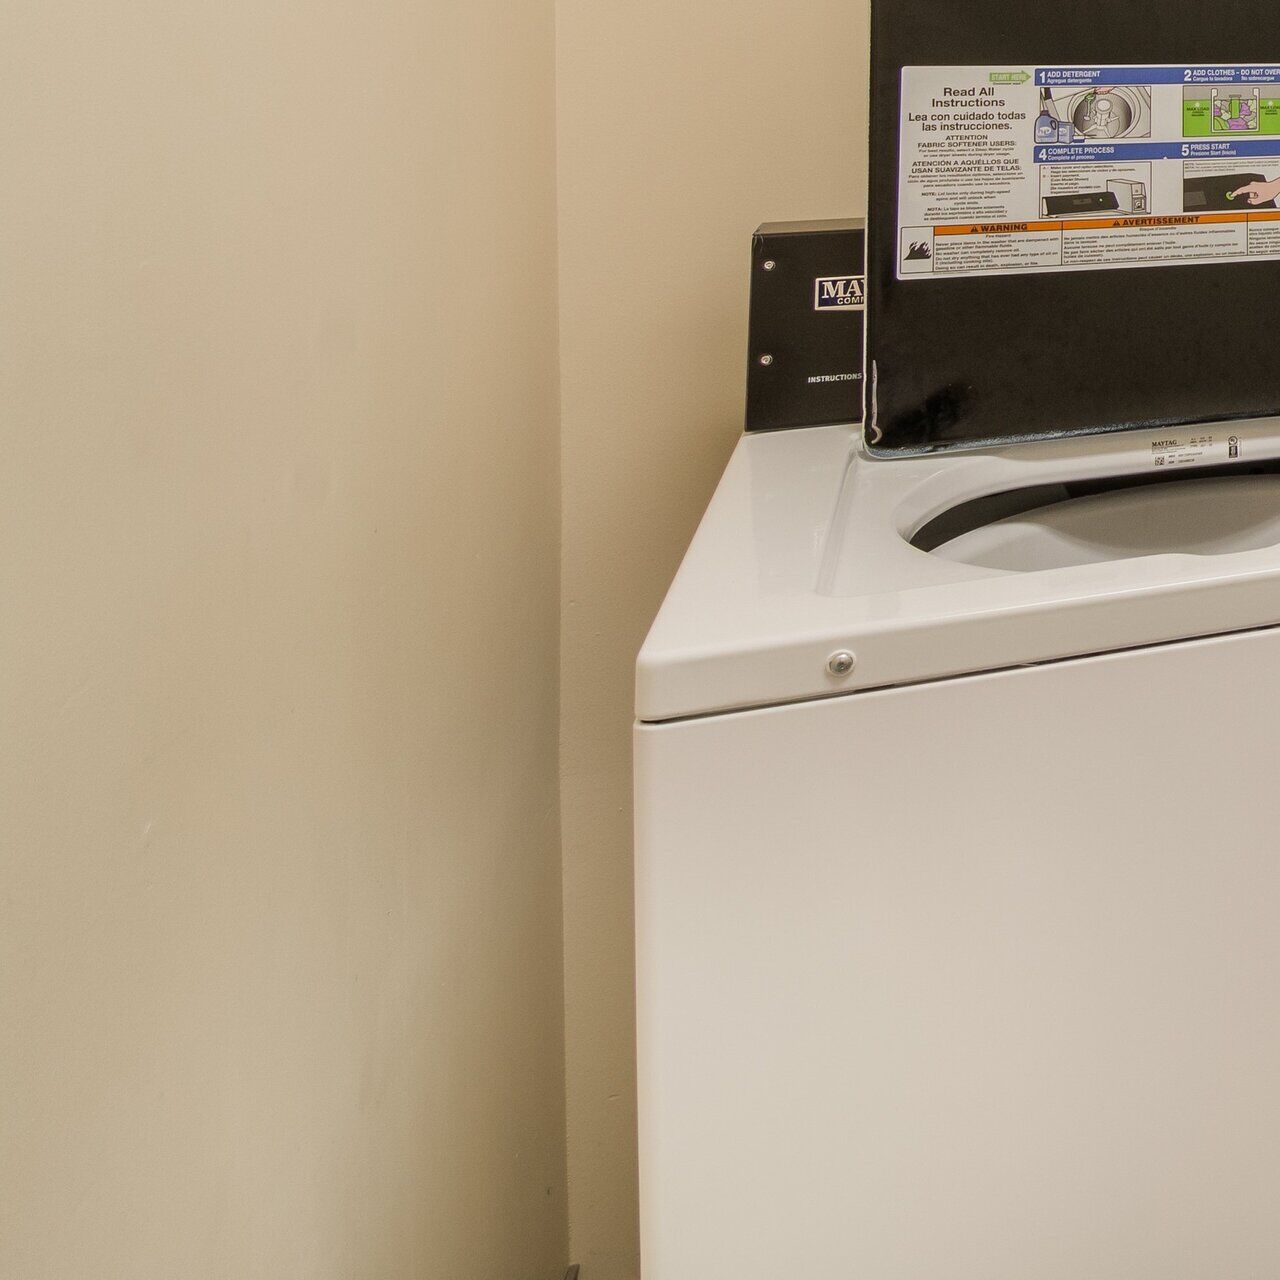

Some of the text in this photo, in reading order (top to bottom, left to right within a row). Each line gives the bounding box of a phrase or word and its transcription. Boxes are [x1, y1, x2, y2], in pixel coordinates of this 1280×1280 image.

[1039, 71, 1046, 84] 1
[1062, 70, 1101, 78] DETERGENT
[1184, 70, 1192, 82] 2
[943, 87, 995, 97] Read All
[932, 98, 1005, 108] Instructions
[908, 111, 1026, 122] Lea con cuidado todas
[922, 122, 1013, 132] las instrucciones.
[1038, 146, 1115, 161] 4 COMPLETE PROCESS
[1182, 144, 1190, 156] 5
[1122, 216, 1201, 226] AVERTISSEMENT
[981, 223, 1028, 233] WARNING
[822, 279, 864, 299] MA
[807, 372, 863, 384] INSTRUCTIONS
[1152, 439, 1178, 448] MAYTAG
